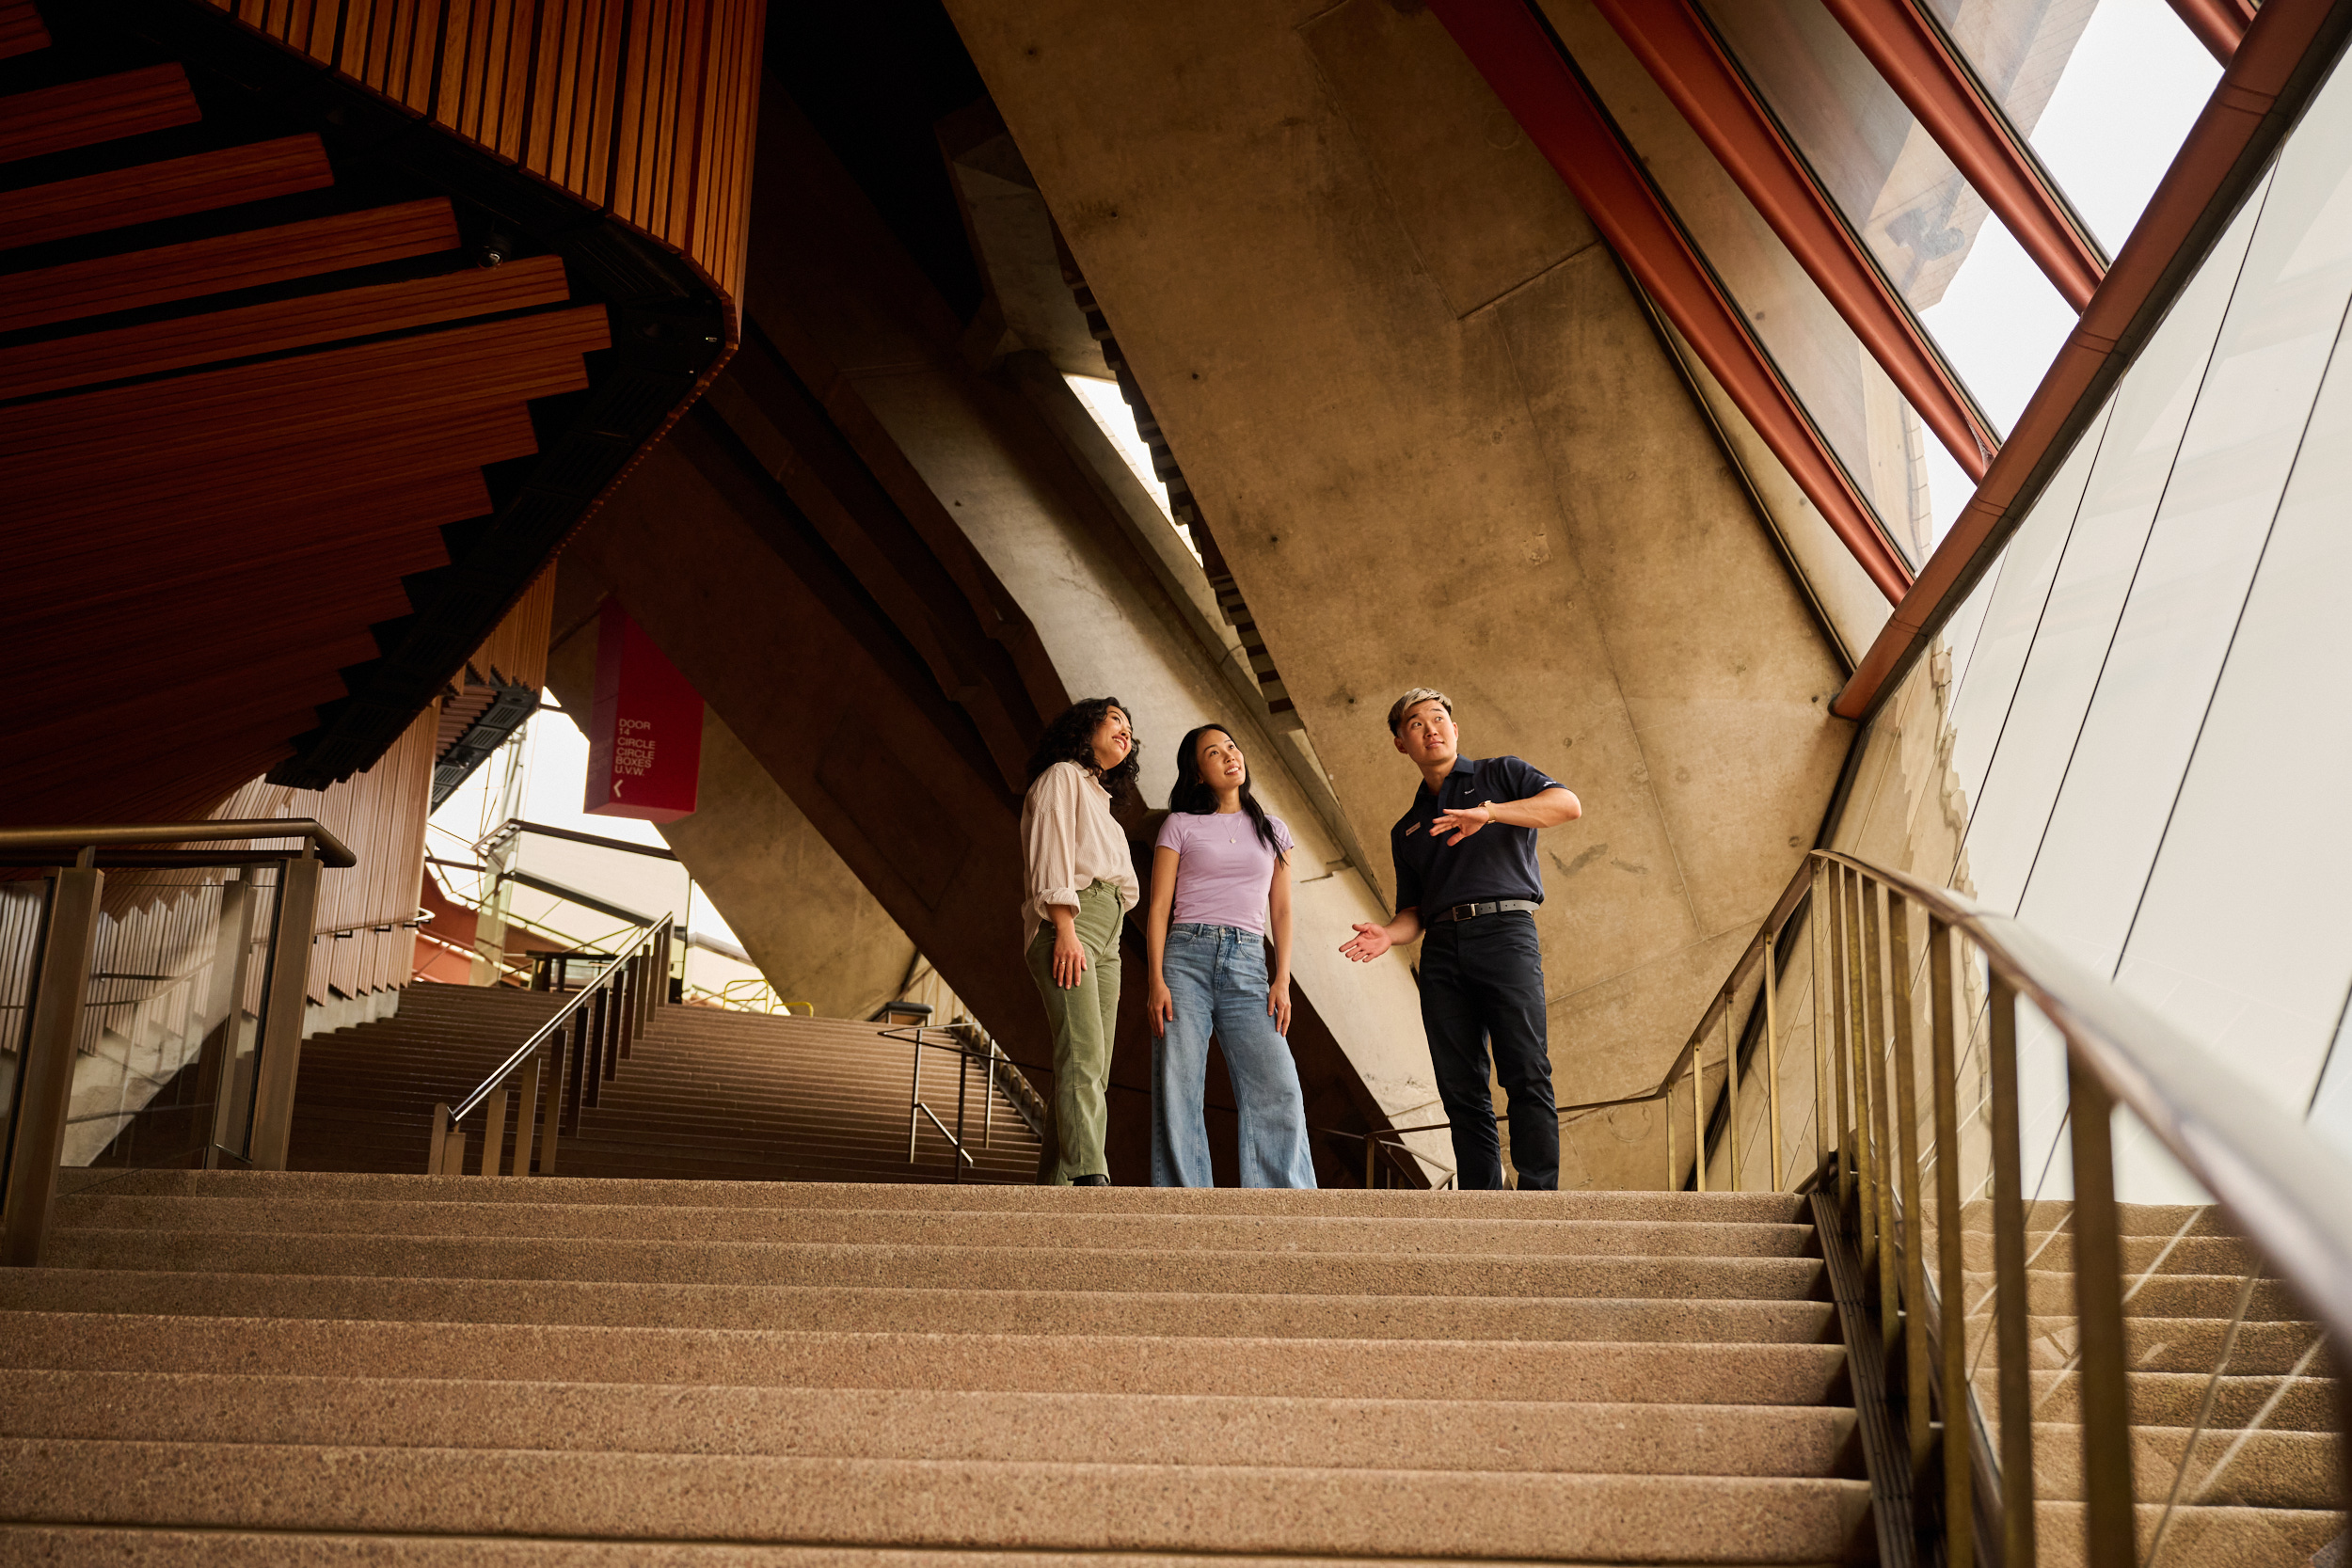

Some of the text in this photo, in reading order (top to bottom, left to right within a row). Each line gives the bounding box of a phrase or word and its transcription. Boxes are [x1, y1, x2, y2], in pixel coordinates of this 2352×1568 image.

[619, 719, 650, 730] DOOR
[617, 737, 656, 750] CIRCLE
[616, 747, 655, 759] CIRCLE
[615, 756, 651, 768] BOXES
